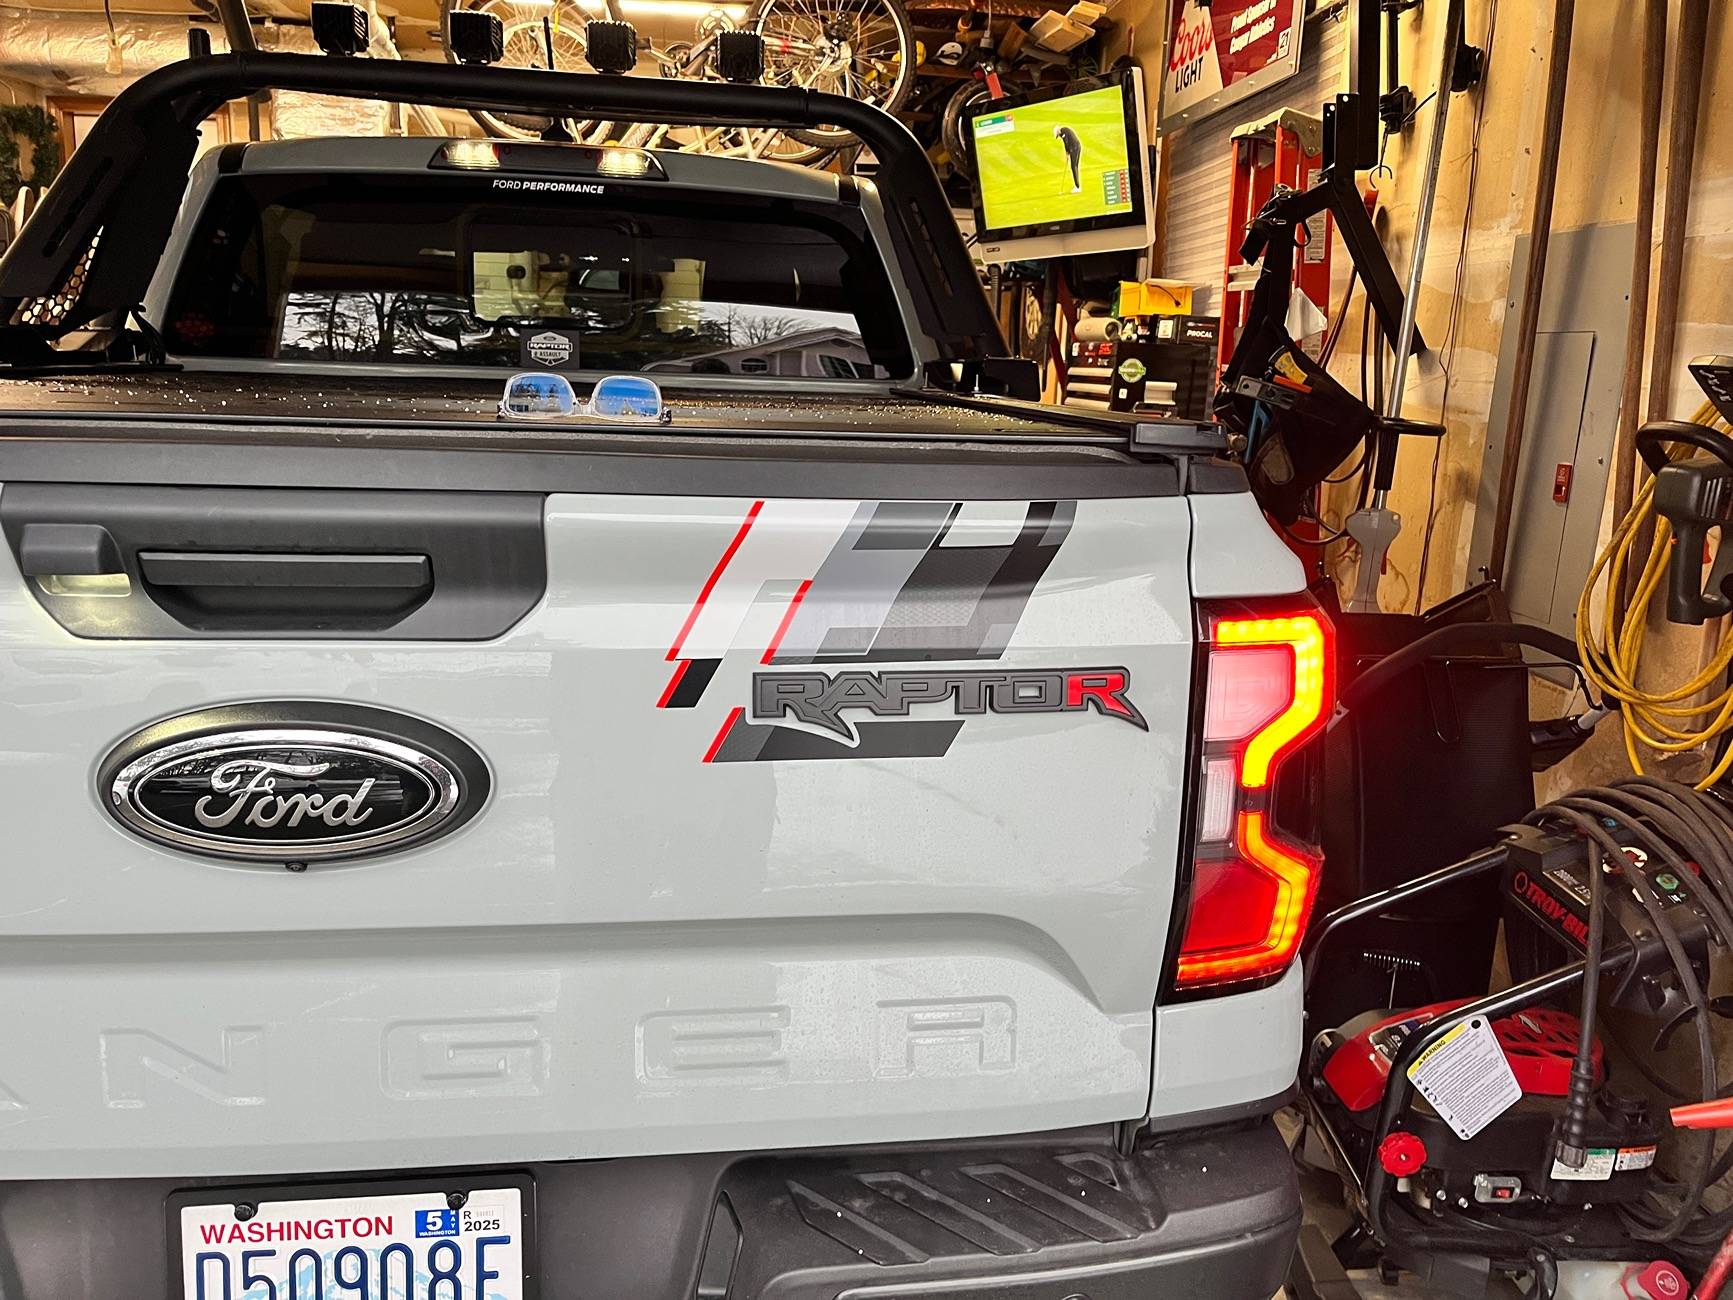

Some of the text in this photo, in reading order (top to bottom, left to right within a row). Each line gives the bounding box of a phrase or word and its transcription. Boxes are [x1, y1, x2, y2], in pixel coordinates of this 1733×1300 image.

[1170, 16, 1214, 72] Coors
[1175, 55, 1204, 94] LIGHT
[492, 179, 605, 194] FORD PERFORMANCE
[752, 666, 1149, 741] RAPTOR
[194, 759, 376, 828] Ford
[1526, 882, 1589, 947] TROY-BIL
[0, 994, 1018, 1109] NGER
[200, 1215, 393, 1245] WASHINGTON
[426, 1211, 443, 1231] 5
[463, 1211, 472, 1220] R
[464, 1220, 500, 1232] 2025
